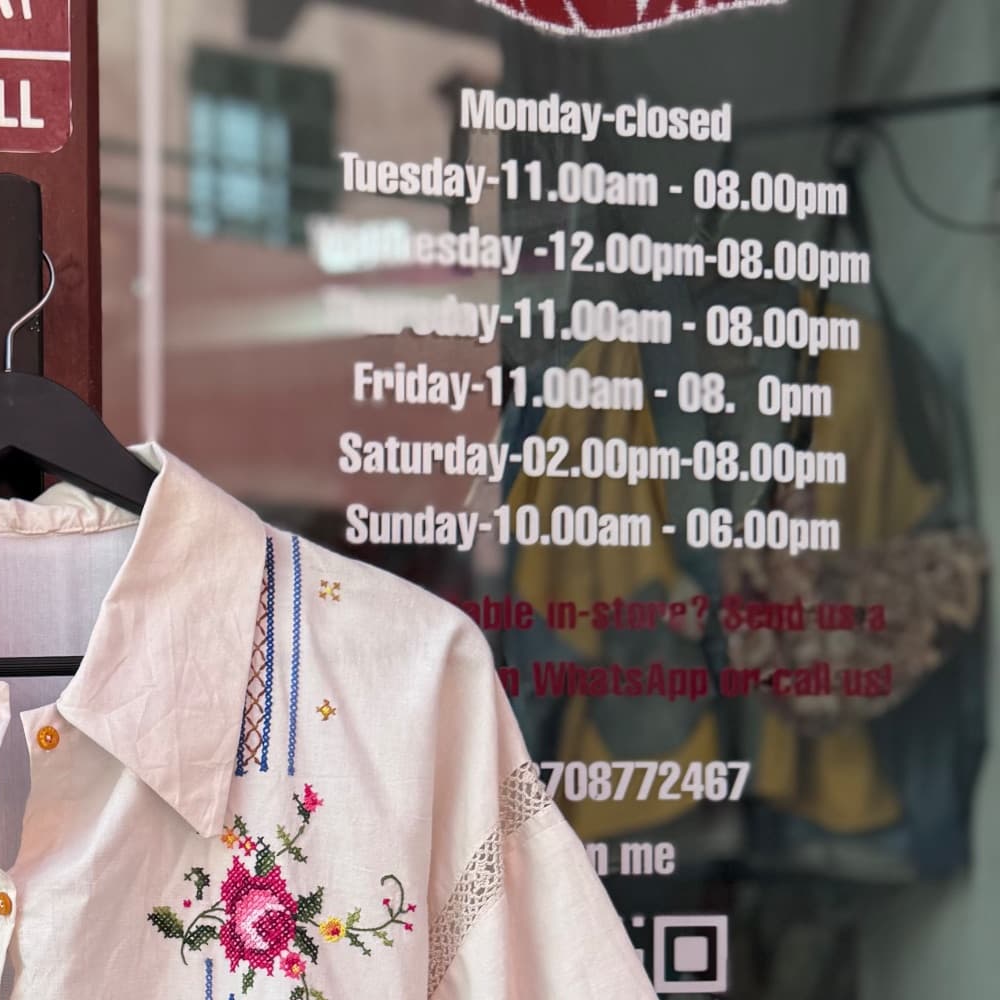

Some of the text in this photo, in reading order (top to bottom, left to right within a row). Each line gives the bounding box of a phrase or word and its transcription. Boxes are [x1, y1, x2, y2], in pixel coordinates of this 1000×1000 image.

[460, 87, 732, 142] Monday-closed
[339, 152, 658, 207] Tuesday-11.00am
[693, 168, 848, 220] 08.00pm
[312, 218, 870, 288] esday -12.00pm-08.00pm
[324, 288, 672, 344] day-11.00am
[706, 304, 860, 356] 08.00pm
[353, 362, 644, 411] Friday-11.00am
[338, 431, 846, 489] Saturday-02.00pm-08.00pm
[345, 504, 651, 551] Sunday-10.00am
[686, 508, 840, 556] 06.00pm
[455, 594, 885, 634] able in-store? Send us a
[533, 661, 708, 702] WhatsApp
[720, 667, 761, 697] or
[773, 660, 829, 696] call
[843, 663, 893, 697] us!
[533, 761, 751, 801] 708772467
[620, 842, 675, 875] me
